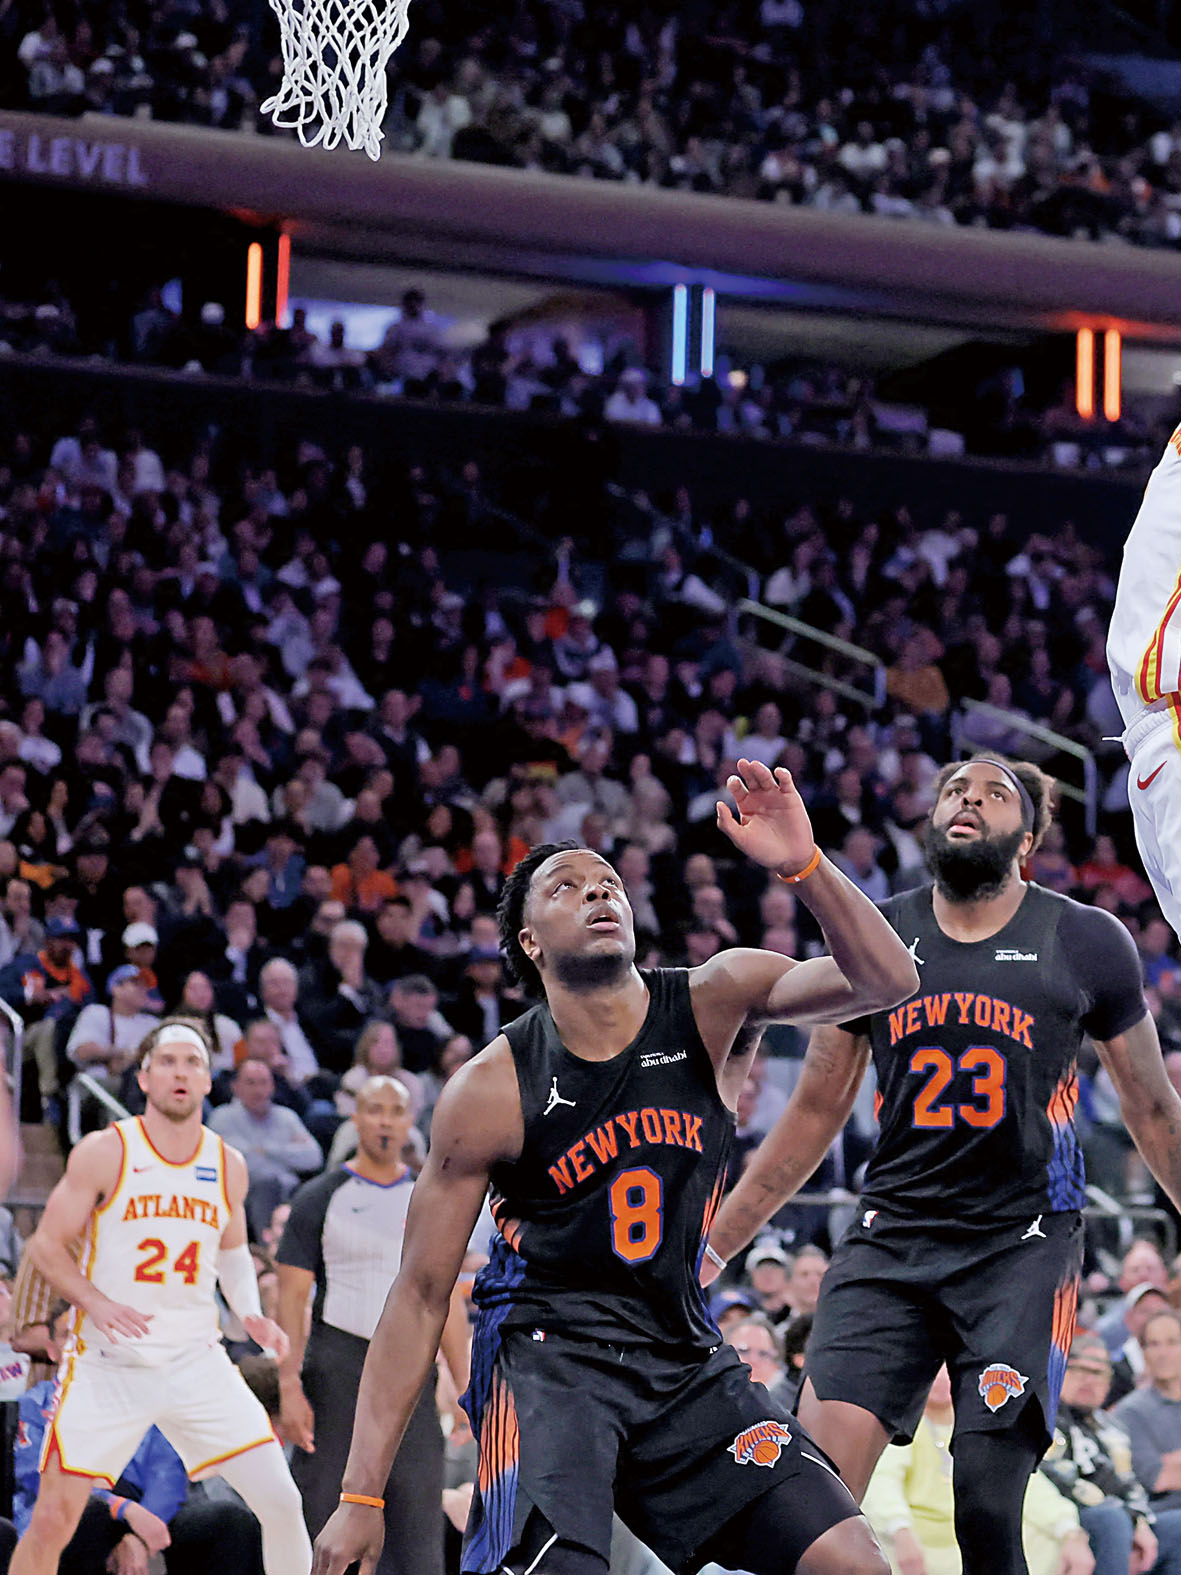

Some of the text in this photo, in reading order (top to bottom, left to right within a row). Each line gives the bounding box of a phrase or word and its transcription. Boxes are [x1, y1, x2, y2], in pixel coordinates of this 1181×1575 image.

[27, 133, 149, 188] LEVEL
[888, 992, 1036, 1050] NEW YORK
[641, 1057, 660, 1068] abu
[660, 1050, 687, 1064] dhabi
[908, 1045, 1007, 1130] 23
[547, 1107, 704, 1195] NEW YORK
[122, 1194, 219, 1230] ATLANTA
[608, 1165, 664, 1264] 8
[134, 1237, 202, 1285] 24
[736, 1422, 791, 1462] KNICKS
